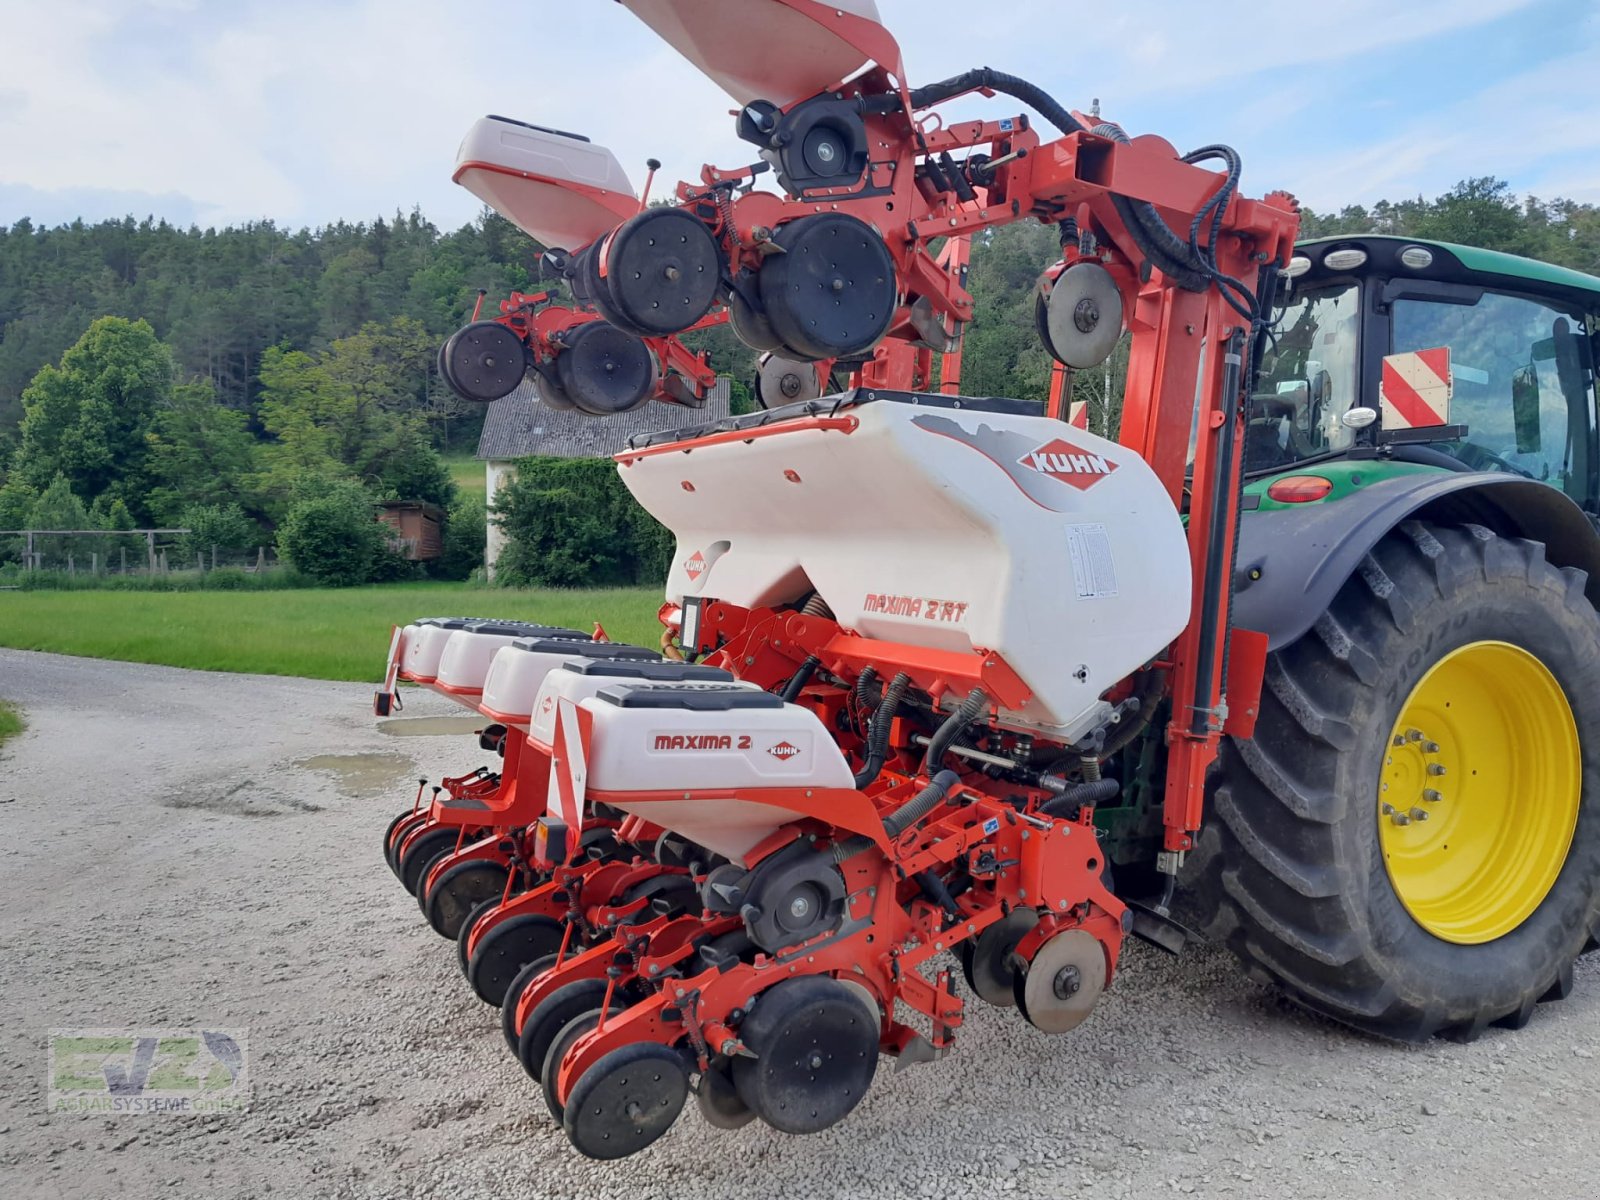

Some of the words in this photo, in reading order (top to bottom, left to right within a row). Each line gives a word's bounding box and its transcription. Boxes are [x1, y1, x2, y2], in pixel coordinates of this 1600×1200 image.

[1030, 452, 1112, 474] KUHN
[863, 593, 922, 617] MAXIMA
[924, 600, 939, 620] 2
[654, 735, 732, 749] MAXIMA
[737, 735, 752, 749] 2
[770, 746, 798, 755] KUHN
